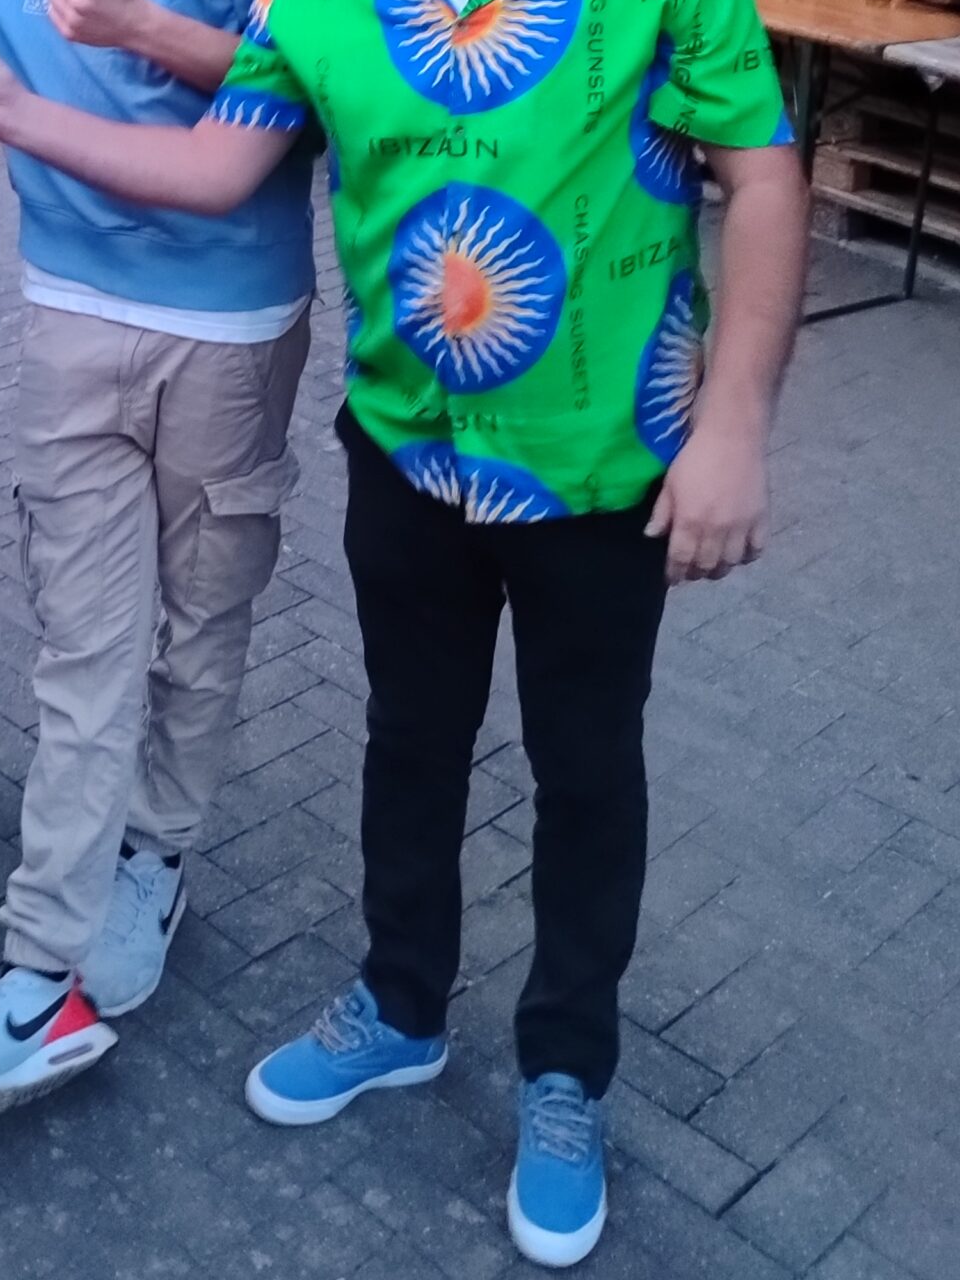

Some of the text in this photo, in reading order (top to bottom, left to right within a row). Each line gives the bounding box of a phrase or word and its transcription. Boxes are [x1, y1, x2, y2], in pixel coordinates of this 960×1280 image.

[584, 23, 605, 135] SUNSETS
[569, 193, 590, 412] CHASING SUNSETS
[608, 235, 682, 281] IBIZA
